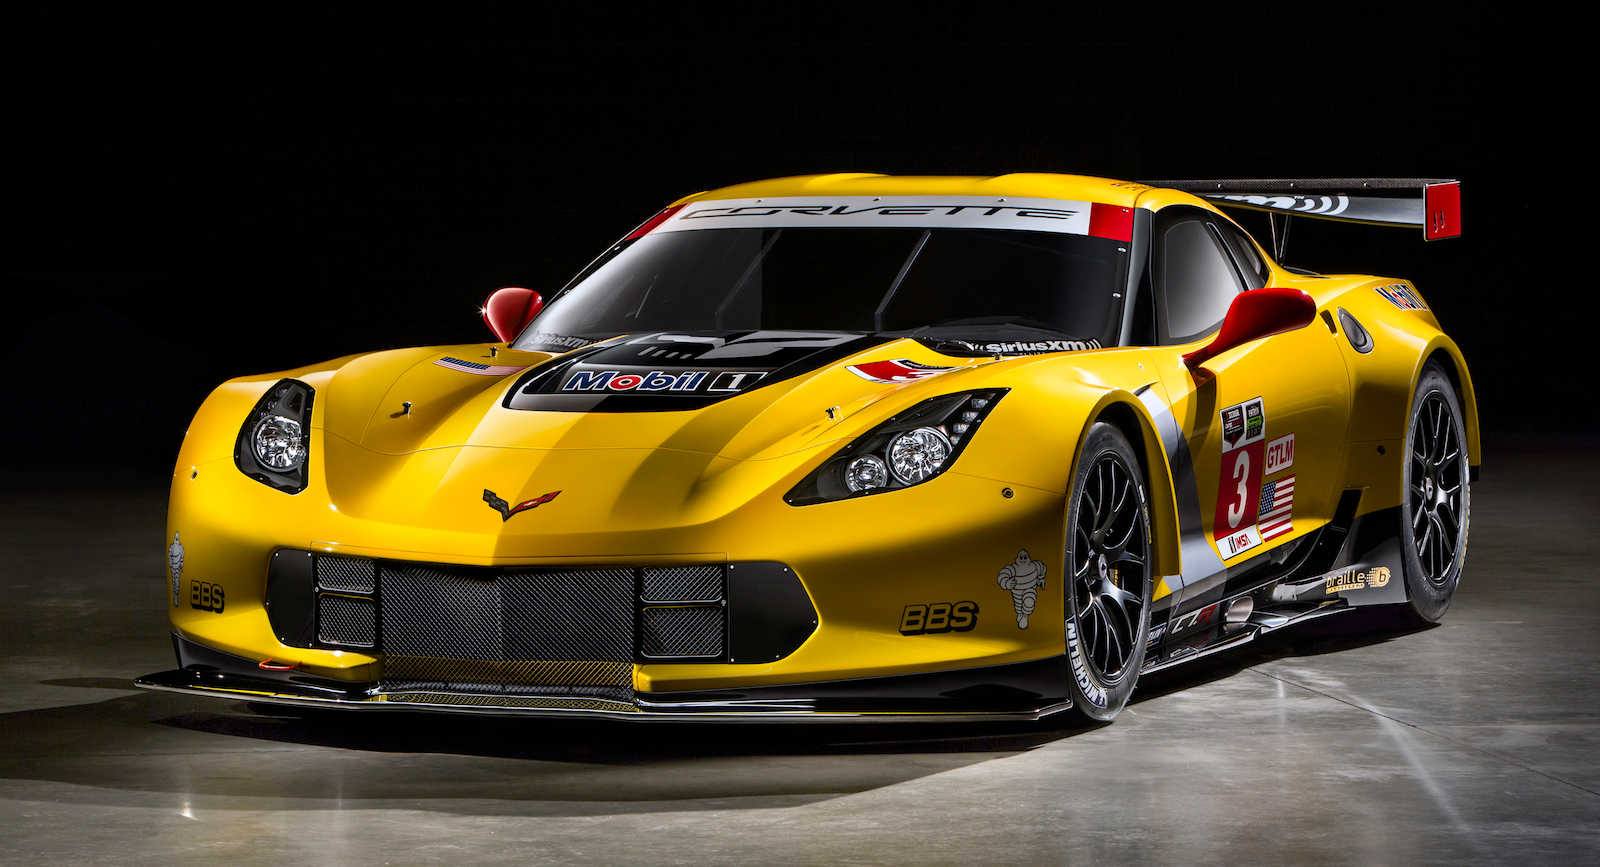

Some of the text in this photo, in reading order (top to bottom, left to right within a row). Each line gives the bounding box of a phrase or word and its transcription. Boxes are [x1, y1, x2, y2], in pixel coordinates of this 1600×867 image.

[680, 205, 1080, 219] CORVETTE
[562, 371, 708, 391] Mobil
[1267, 438, 1294, 468] GTLM
[1228, 450, 1250, 529] 3
[1326, 569, 1365, 588] braille
[191, 579, 225, 614] BBS
[899, 601, 979, 636] BBS
[1067, 622, 1100, 703] MICHELIN
